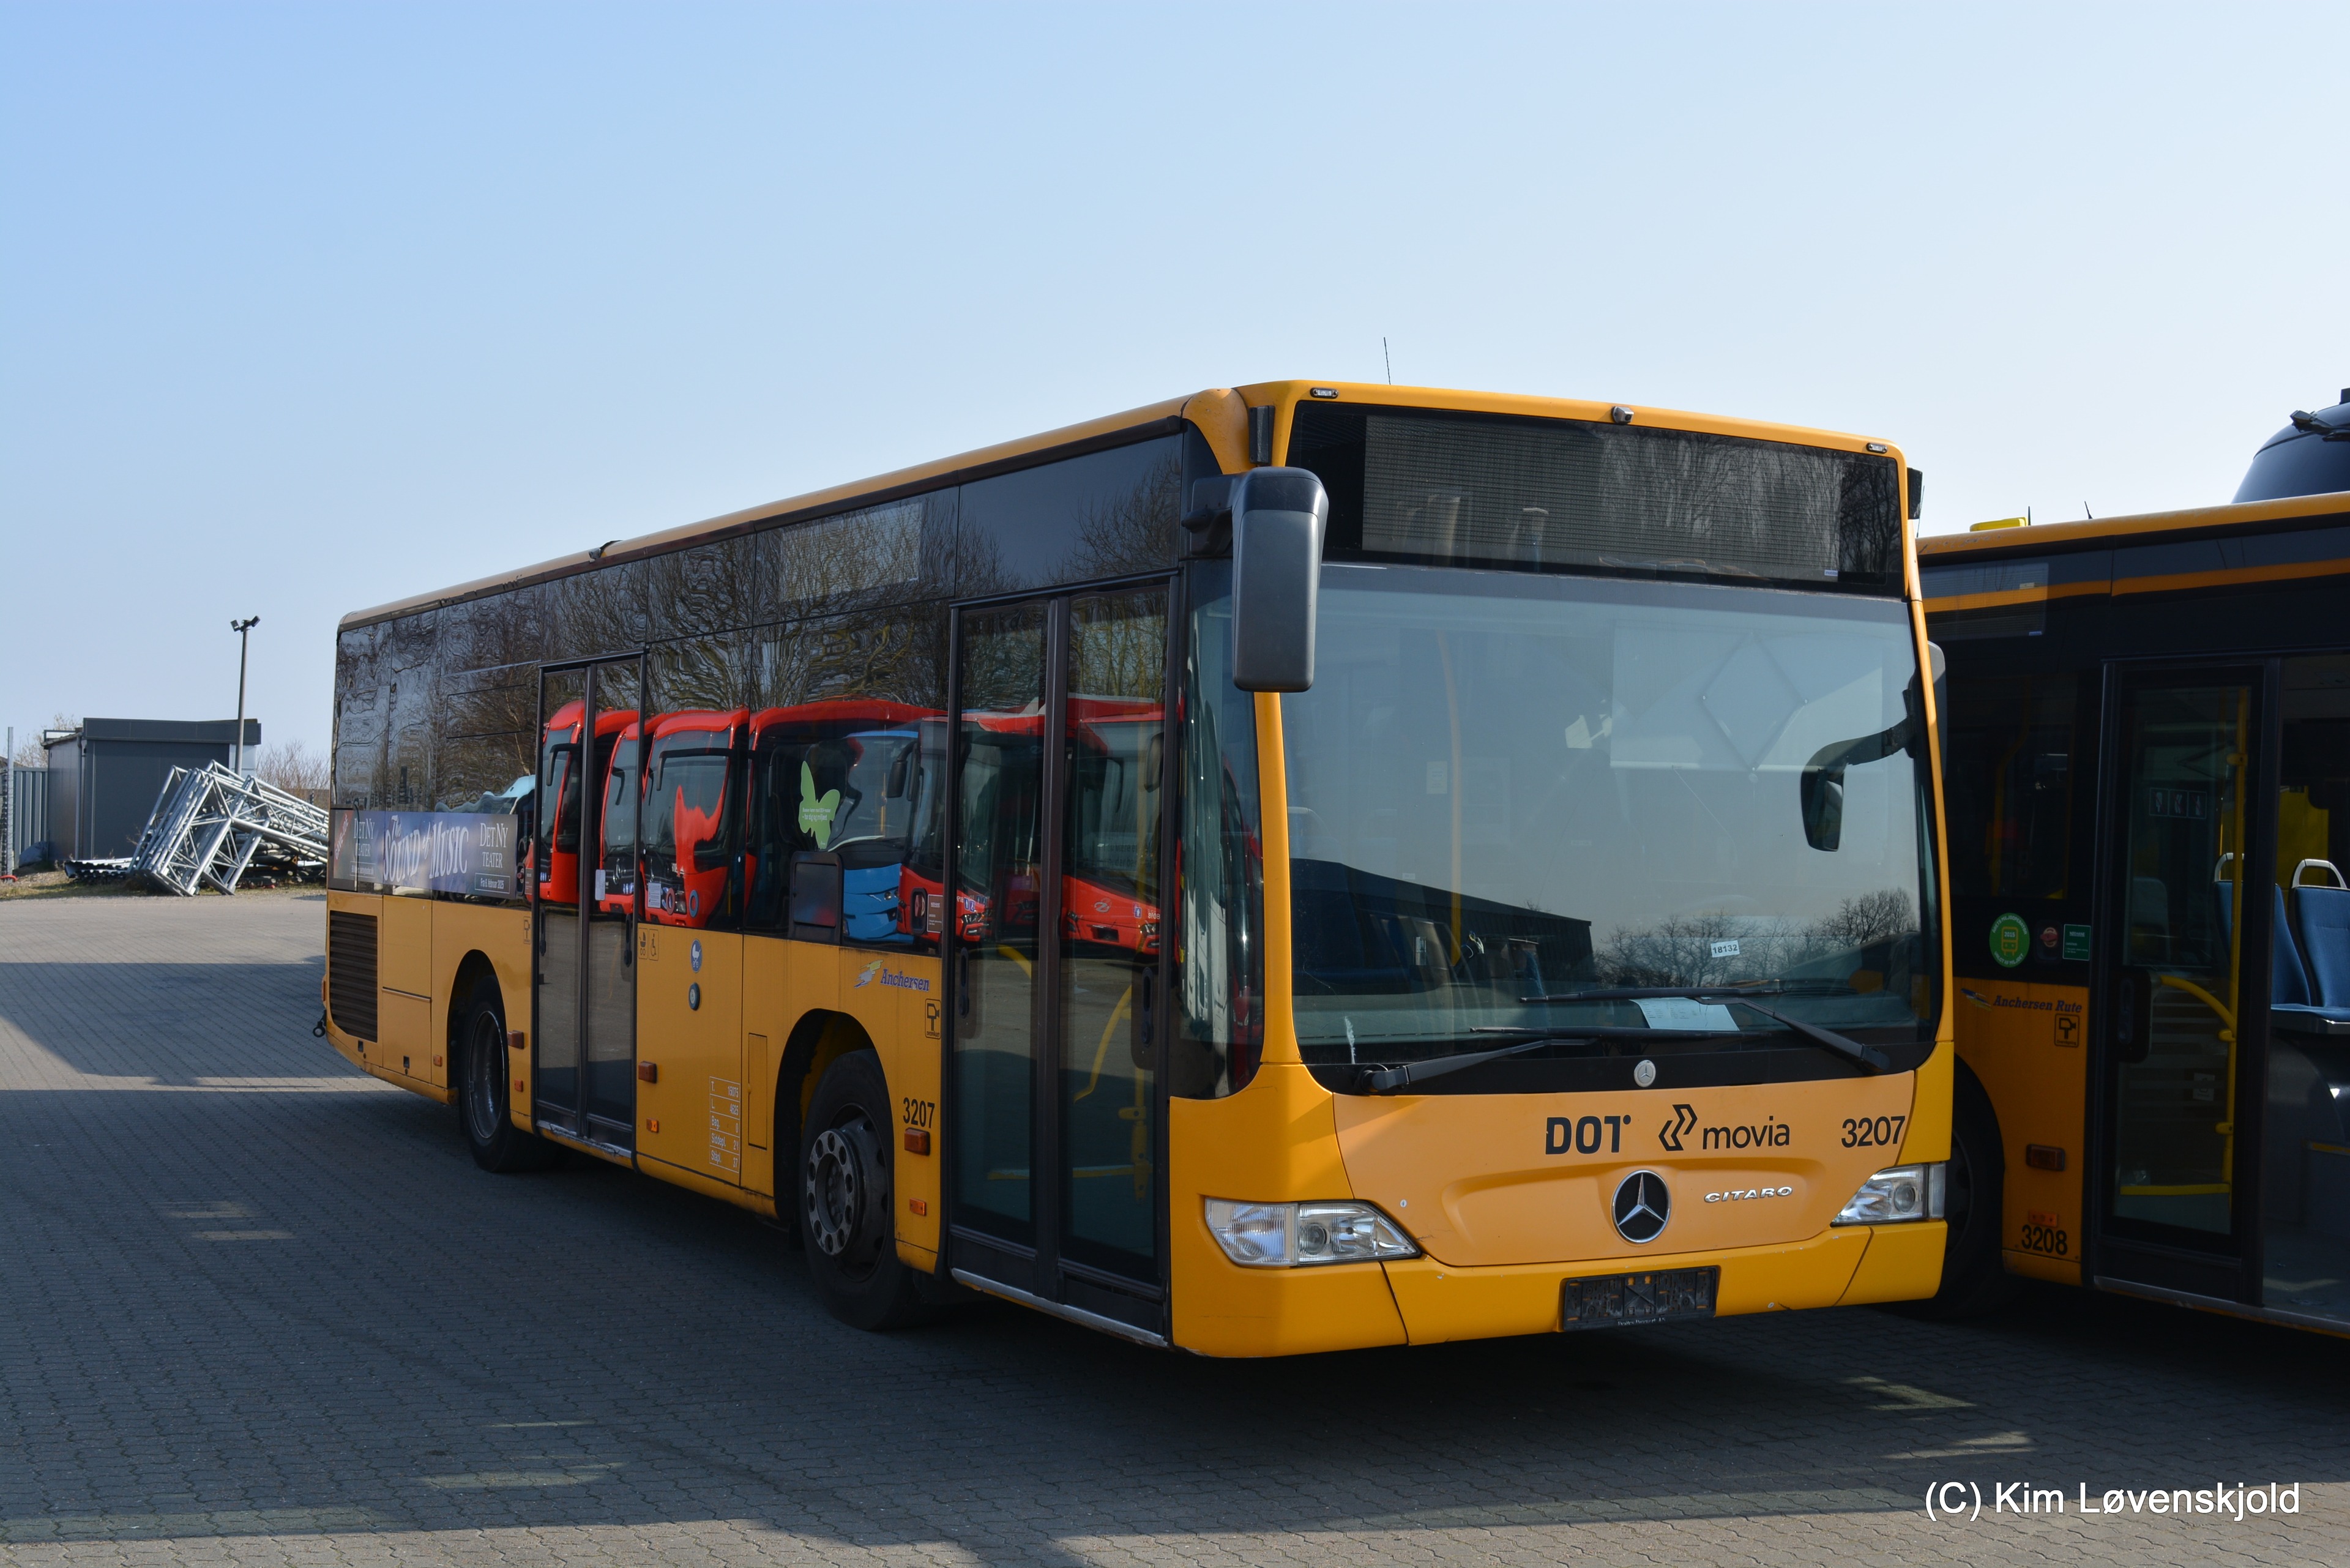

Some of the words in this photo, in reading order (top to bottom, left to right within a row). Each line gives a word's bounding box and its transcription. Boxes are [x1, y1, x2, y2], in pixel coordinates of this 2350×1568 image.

[391, 815, 402, 840] The
[383, 829, 420, 883] SOUND
[422, 821, 431, 860] of
[429, 820, 469, 879] MUSIC
[482, 851, 503, 868] TEATER
[1712, 944, 1738, 954] 18132
[880, 968, 930, 992] Anchersen
[1993, 995, 2053, 1010] Anchersen
[2055, 1000, 2082, 1013] Rute
[903, 1097, 935, 1129] 3207
[1545, 1114, 1628, 1155] DOT
[1702, 1115, 1791, 1150] movia
[1841, 1116, 1906, 1148] 3207
[1704, 1185, 1794, 1203] CITARO
[2021, 1224, 2067, 1255] 3208
